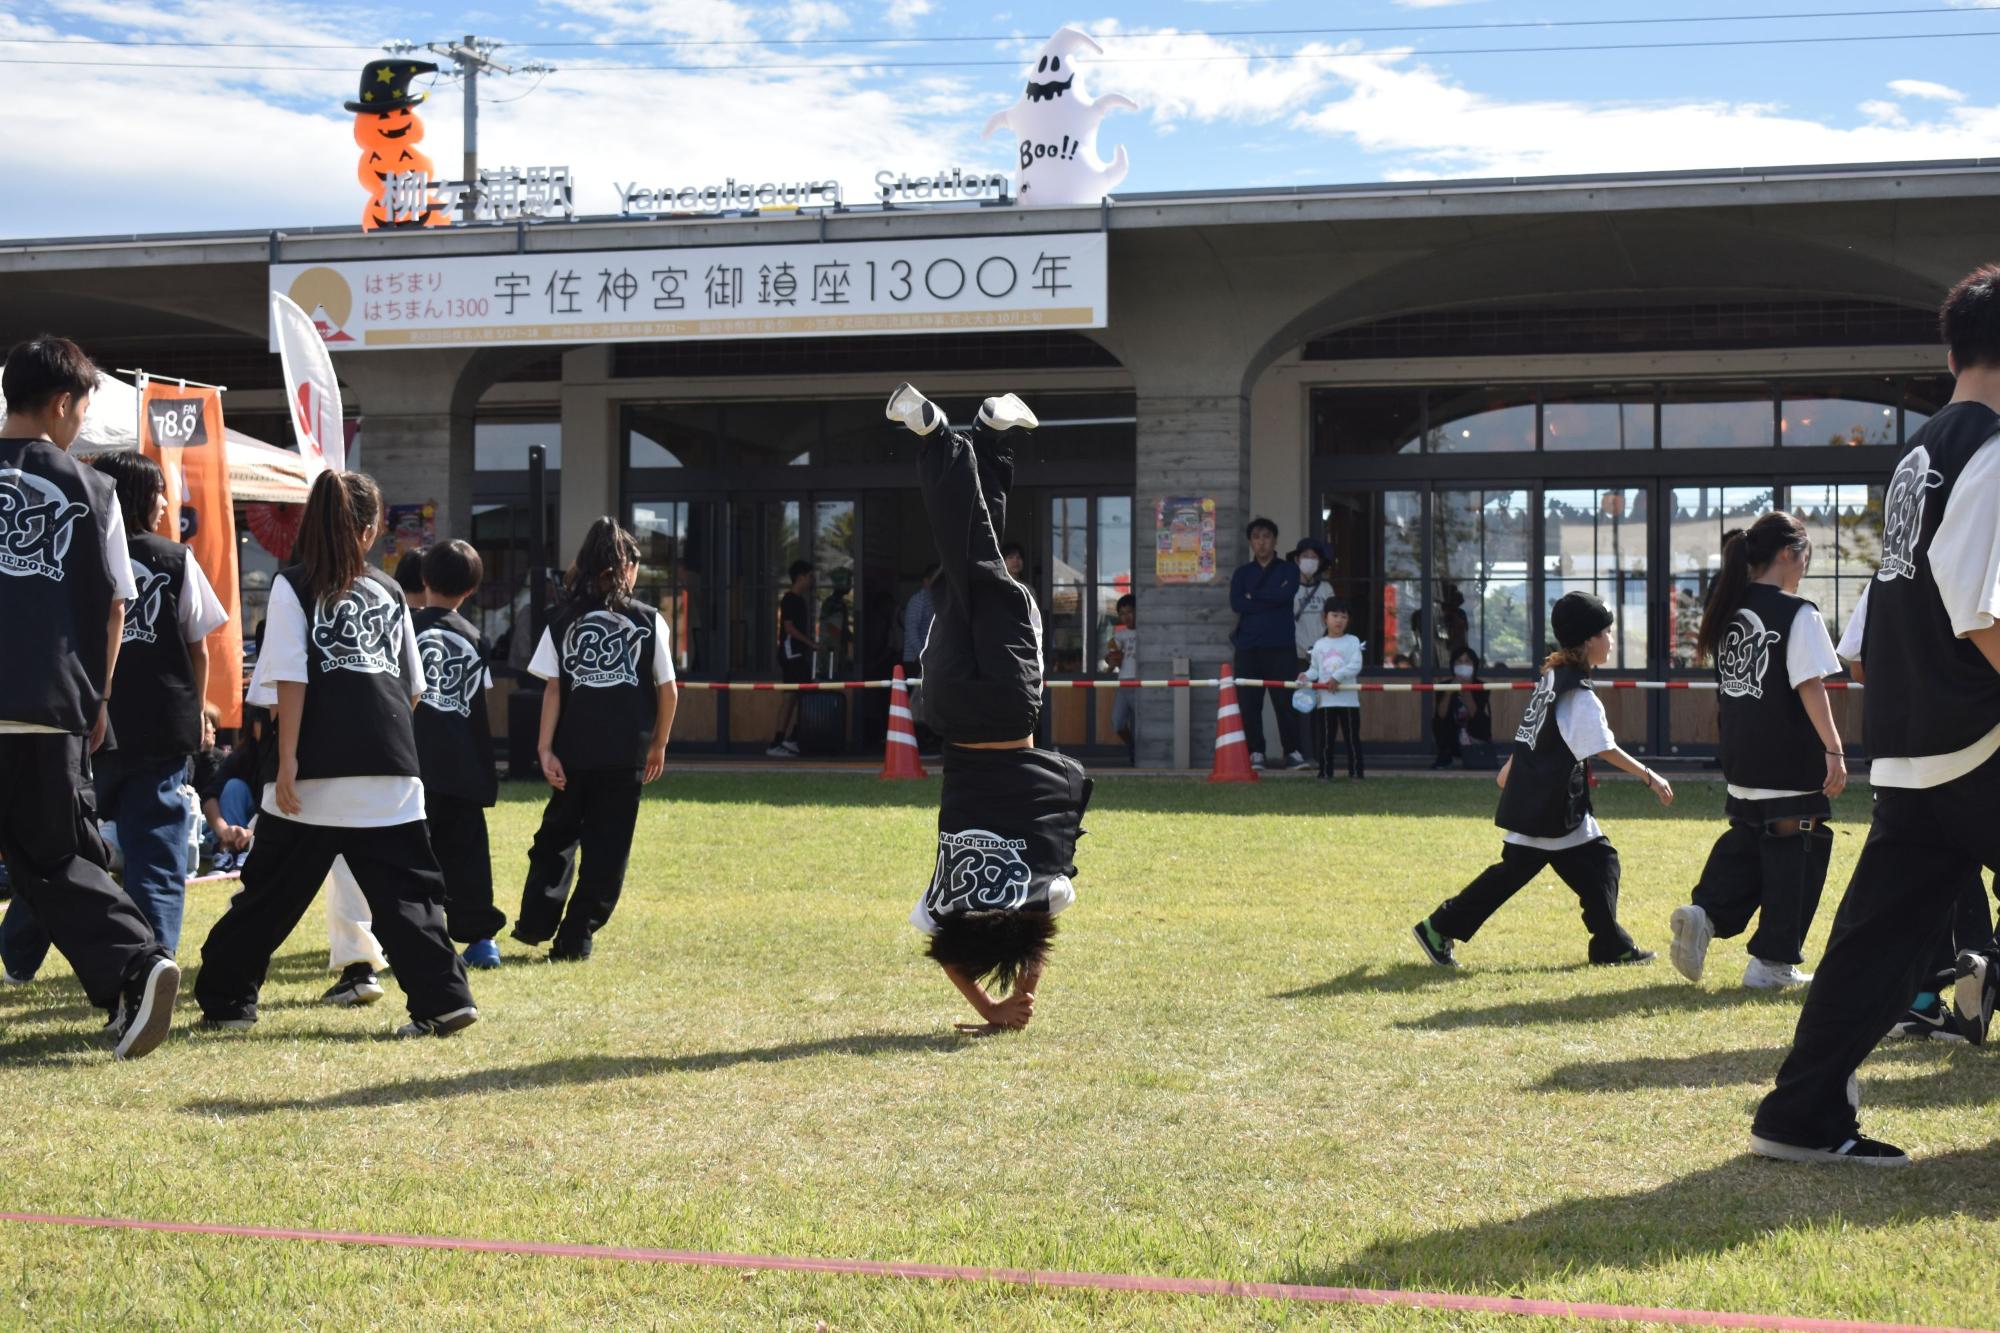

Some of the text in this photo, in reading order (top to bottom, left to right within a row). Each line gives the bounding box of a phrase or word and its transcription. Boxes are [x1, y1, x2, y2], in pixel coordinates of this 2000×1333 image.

[1019, 134, 1079, 170] Boo!!
[613, 168, 1006, 214] Yanagigaura Station
[364, 297, 490, 321] はちまん1300
[183, 404, 197, 417] FM
[152, 410, 197, 442] 78.9
[16, 558, 65, 581] DOWN
[976, 838, 1027, 850] BOOGIE
